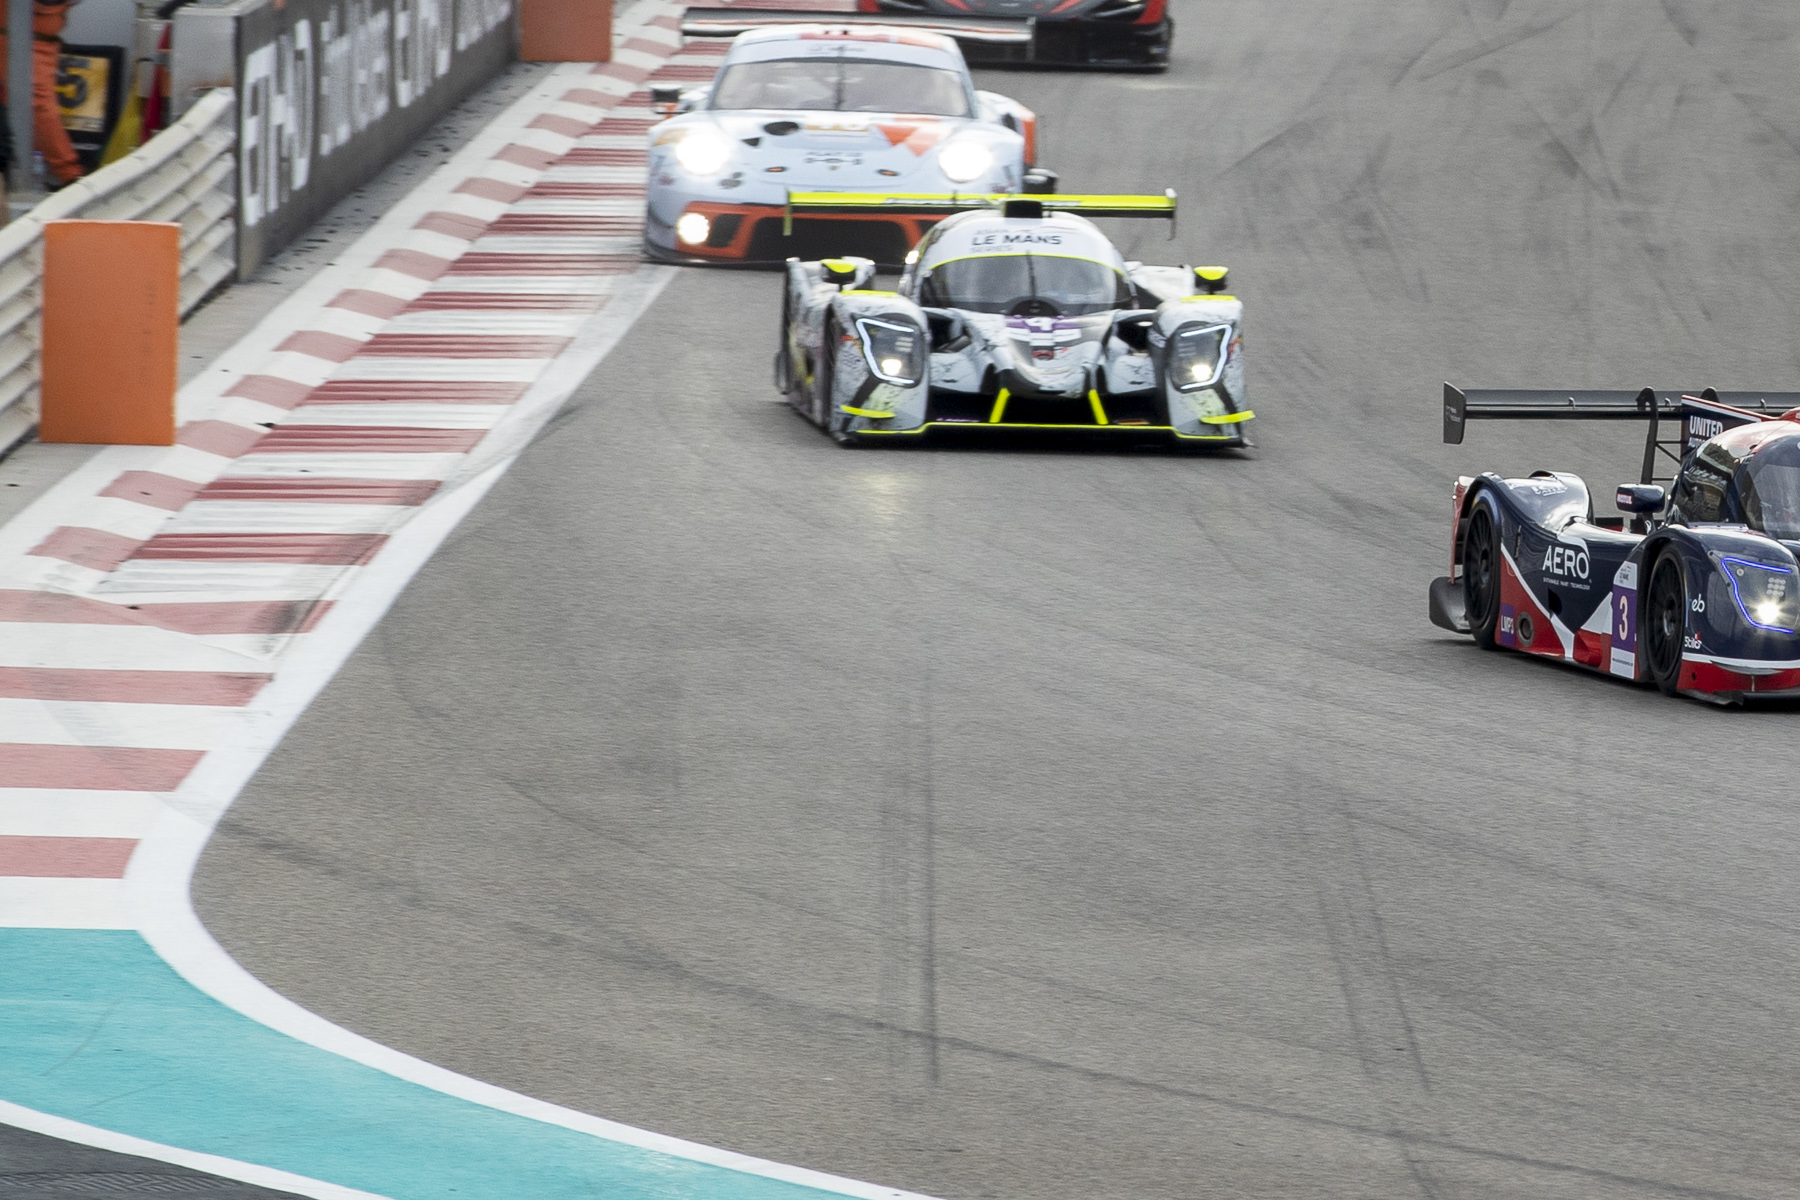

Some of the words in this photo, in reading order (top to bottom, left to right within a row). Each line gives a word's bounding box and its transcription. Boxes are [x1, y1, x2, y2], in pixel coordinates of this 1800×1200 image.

[971, 235, 996, 246] LE
[1002, 234, 1063, 245] MANS
[1689, 415, 1724, 438] UNITED
[1542, 545, 1590, 580] AERO
[1618, 595, 1629, 641] 3
